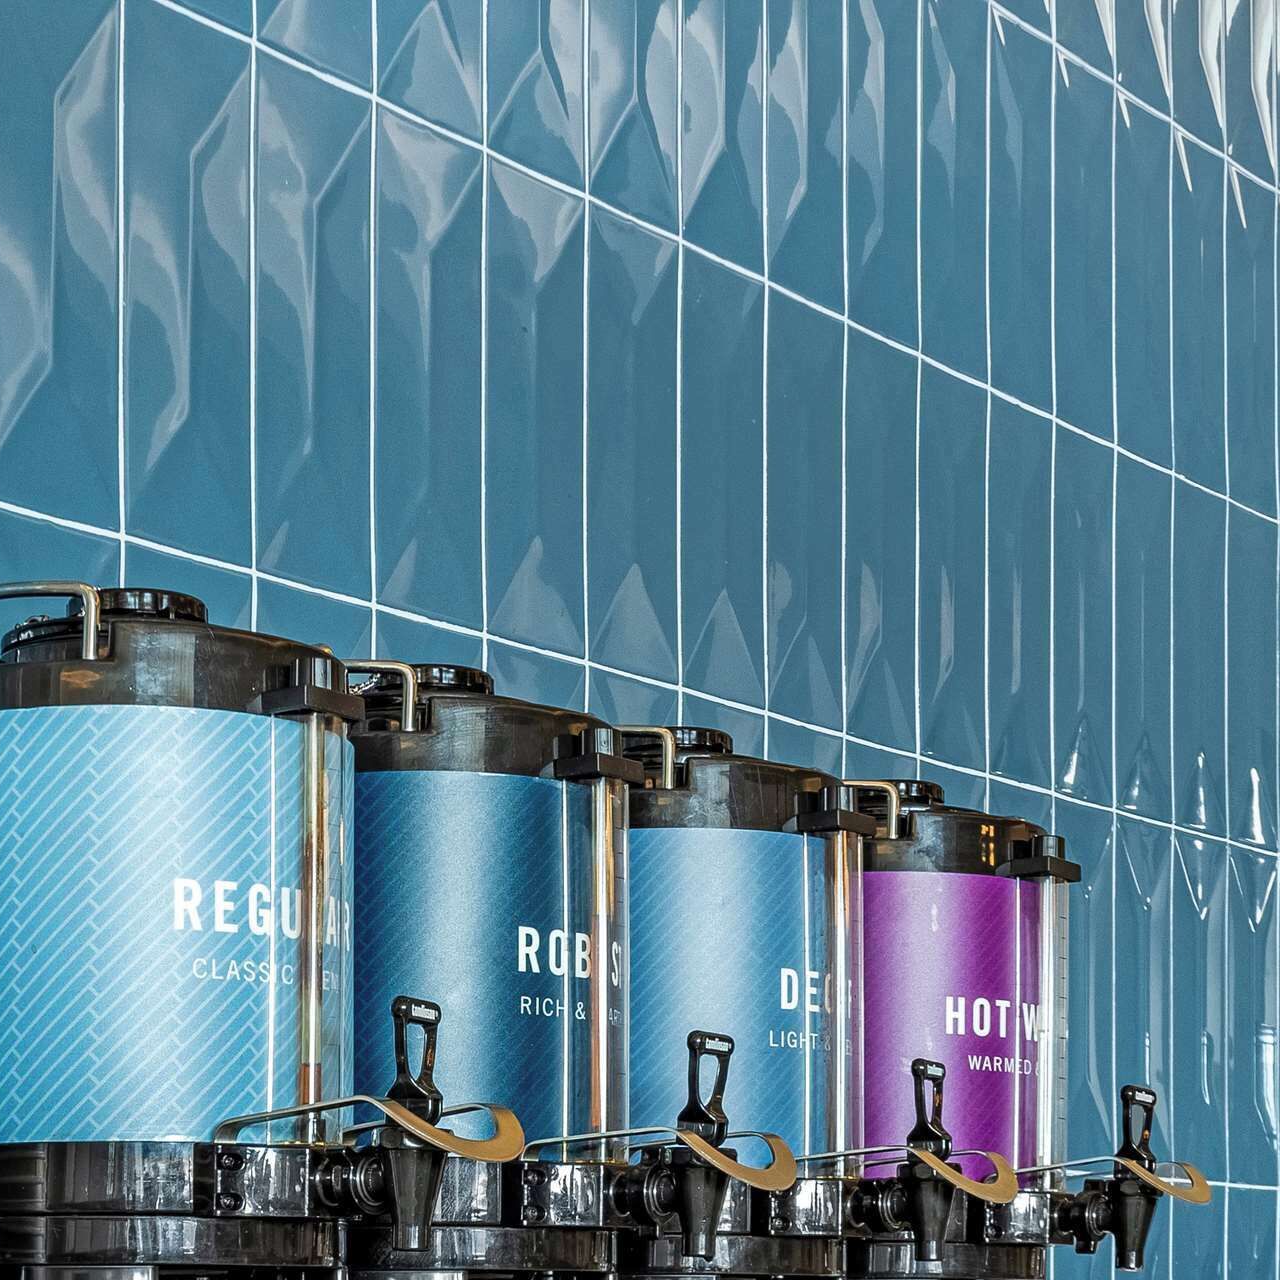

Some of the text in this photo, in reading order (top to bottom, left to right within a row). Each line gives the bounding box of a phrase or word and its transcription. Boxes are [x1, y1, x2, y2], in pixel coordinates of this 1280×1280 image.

[173, 877, 350, 952] REGUAR
[521, 996, 568, 1017] RICH
[575, 1002, 586, 1020] &
[945, 996, 1011, 1038] HOT
[770, 1030, 818, 1049] LIGHT
[968, 1055, 1032, 1075] WARMED
